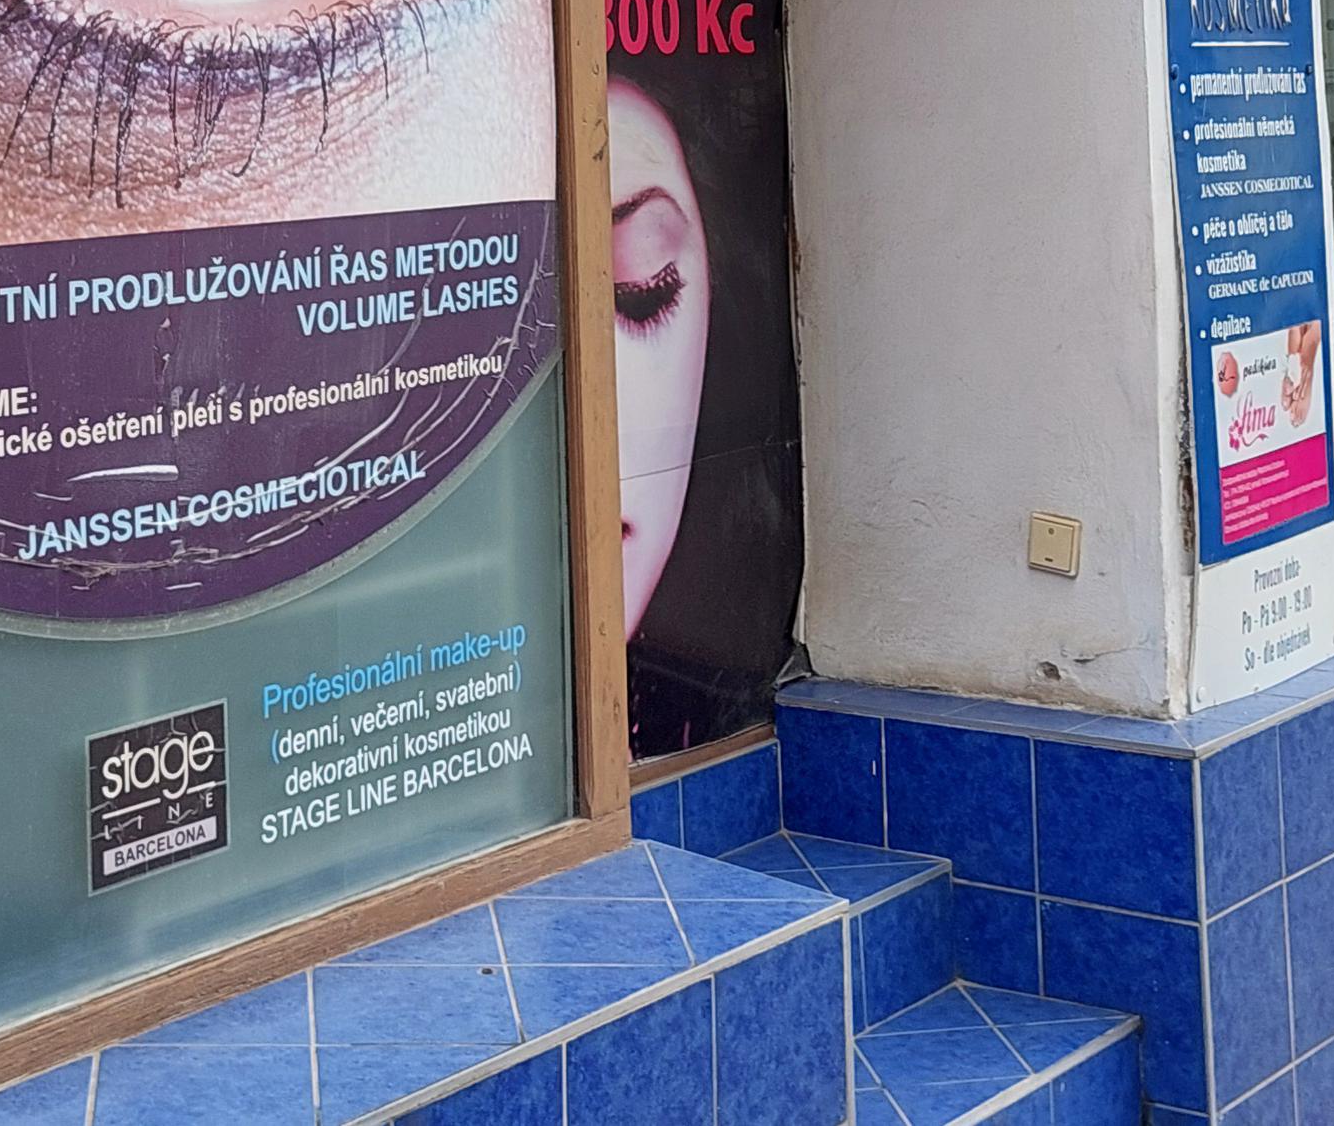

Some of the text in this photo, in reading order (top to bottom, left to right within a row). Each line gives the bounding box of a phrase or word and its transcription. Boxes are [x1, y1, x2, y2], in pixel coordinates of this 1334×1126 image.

[1190, 67, 1244, 104] permanentní
[1244, 66, 1293, 102] prodlužování
[1194, 114, 1296, 146] profesionální německá
[1196, 149, 1247, 174] kosmetika
[1200, 174, 1315, 199] JANSSEN COSMECIOTICAL
[1203, 209, 1295, 245] péče o obličej a tělo
[68, 245, 323, 317] PRODLUŽOVÁNÍ
[330, 244, 388, 284] ŘAS
[394, 233, 519, 281] METODOU
[1208, 279, 1259, 300] GERMAINE
[1259, 276, 1270, 292] de
[297, 275, 519, 337] VOLUME LASHES
[1210, 314, 1252, 341] depilace
[60, 406, 164, 449] ošetření
[172, 392, 224, 437] pleti
[228, 399, 244, 423] s
[248, 368, 390, 427] profesionální
[394, 355, 503, 395] kosmetikou
[18, 450, 426, 561] JANSSEN COSMECIOTICAL
[1242, 611, 1252, 635] Po
[262, 624, 526, 718] Profesionální make-up
[271, 660, 523, 764] (denní, večerní, svatební)
[101, 730, 215, 800] stage
[284, 707, 511, 796] dekorativní kosmetikou
[260, 733, 534, 844] STAGE LINE BARCELONA
[113, 824, 207, 868] BARCELONA
